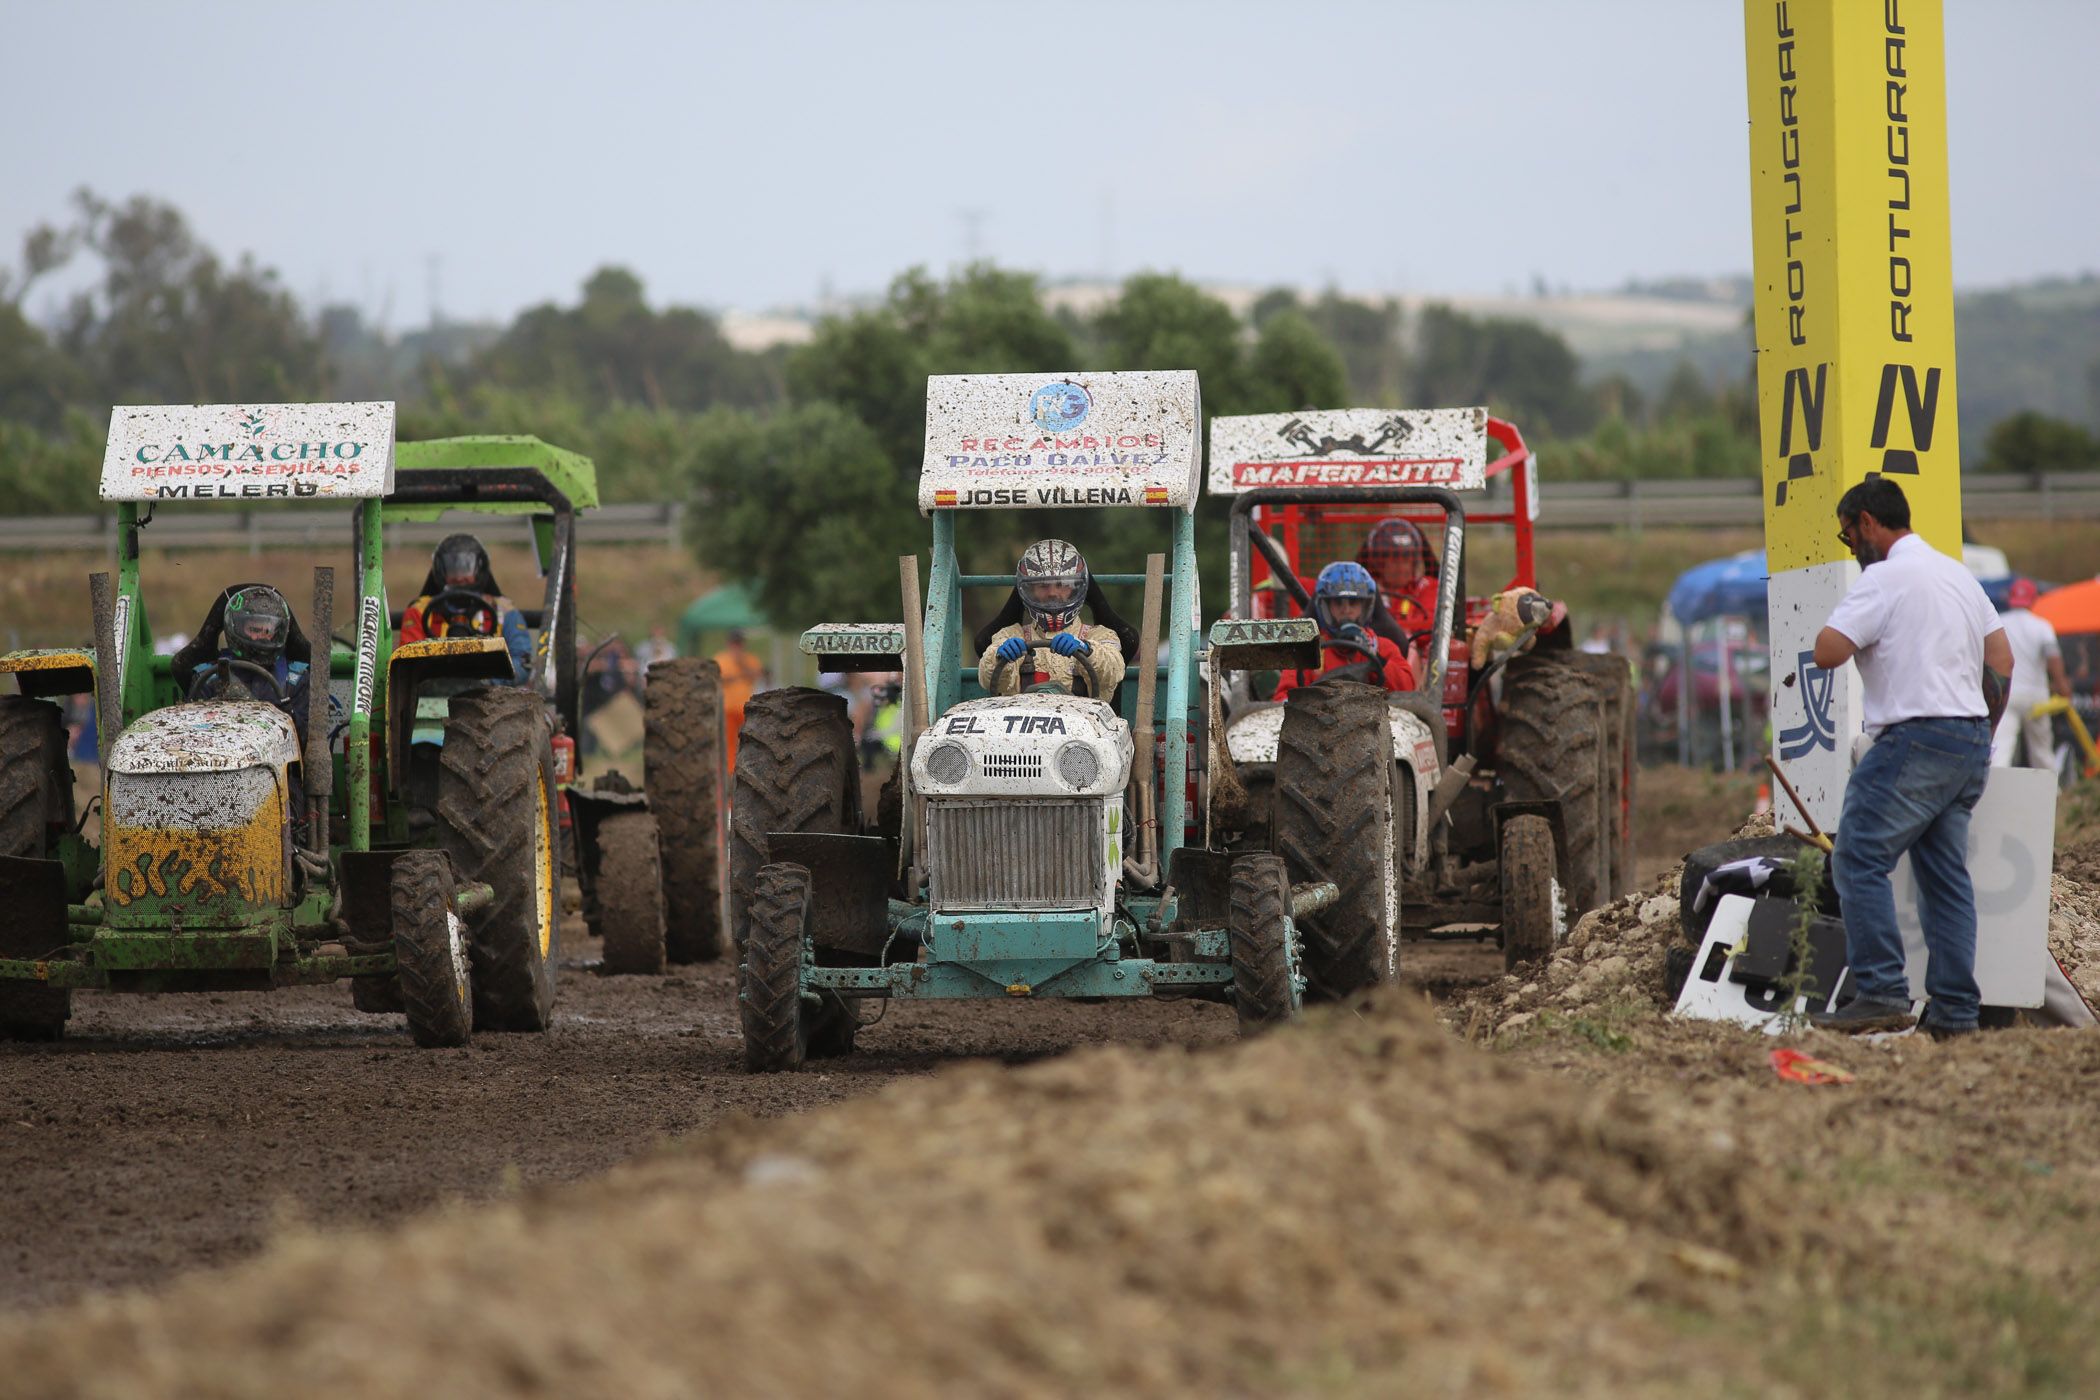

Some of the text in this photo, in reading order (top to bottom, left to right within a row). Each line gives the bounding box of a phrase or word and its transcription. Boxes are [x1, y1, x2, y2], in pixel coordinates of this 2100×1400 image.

[1776, 1, 1807, 346] ROTUGRAF
[136, 441, 362, 463] CAMACHO
[962, 434, 1160, 452] RECAMBIOS
[131, 463, 361, 477] PIENSOS Y SEMILLAS
[1240, 461, 1455, 484] MAFERAUTO
[158, 483, 319, 498] MELERO
[960, 487, 1132, 505] JOSE VILLENA
[1225, 624, 1299, 641] ANA
[813, 635, 893, 651] ALVARO
[946, 715, 1066, 735] EL TIRA
